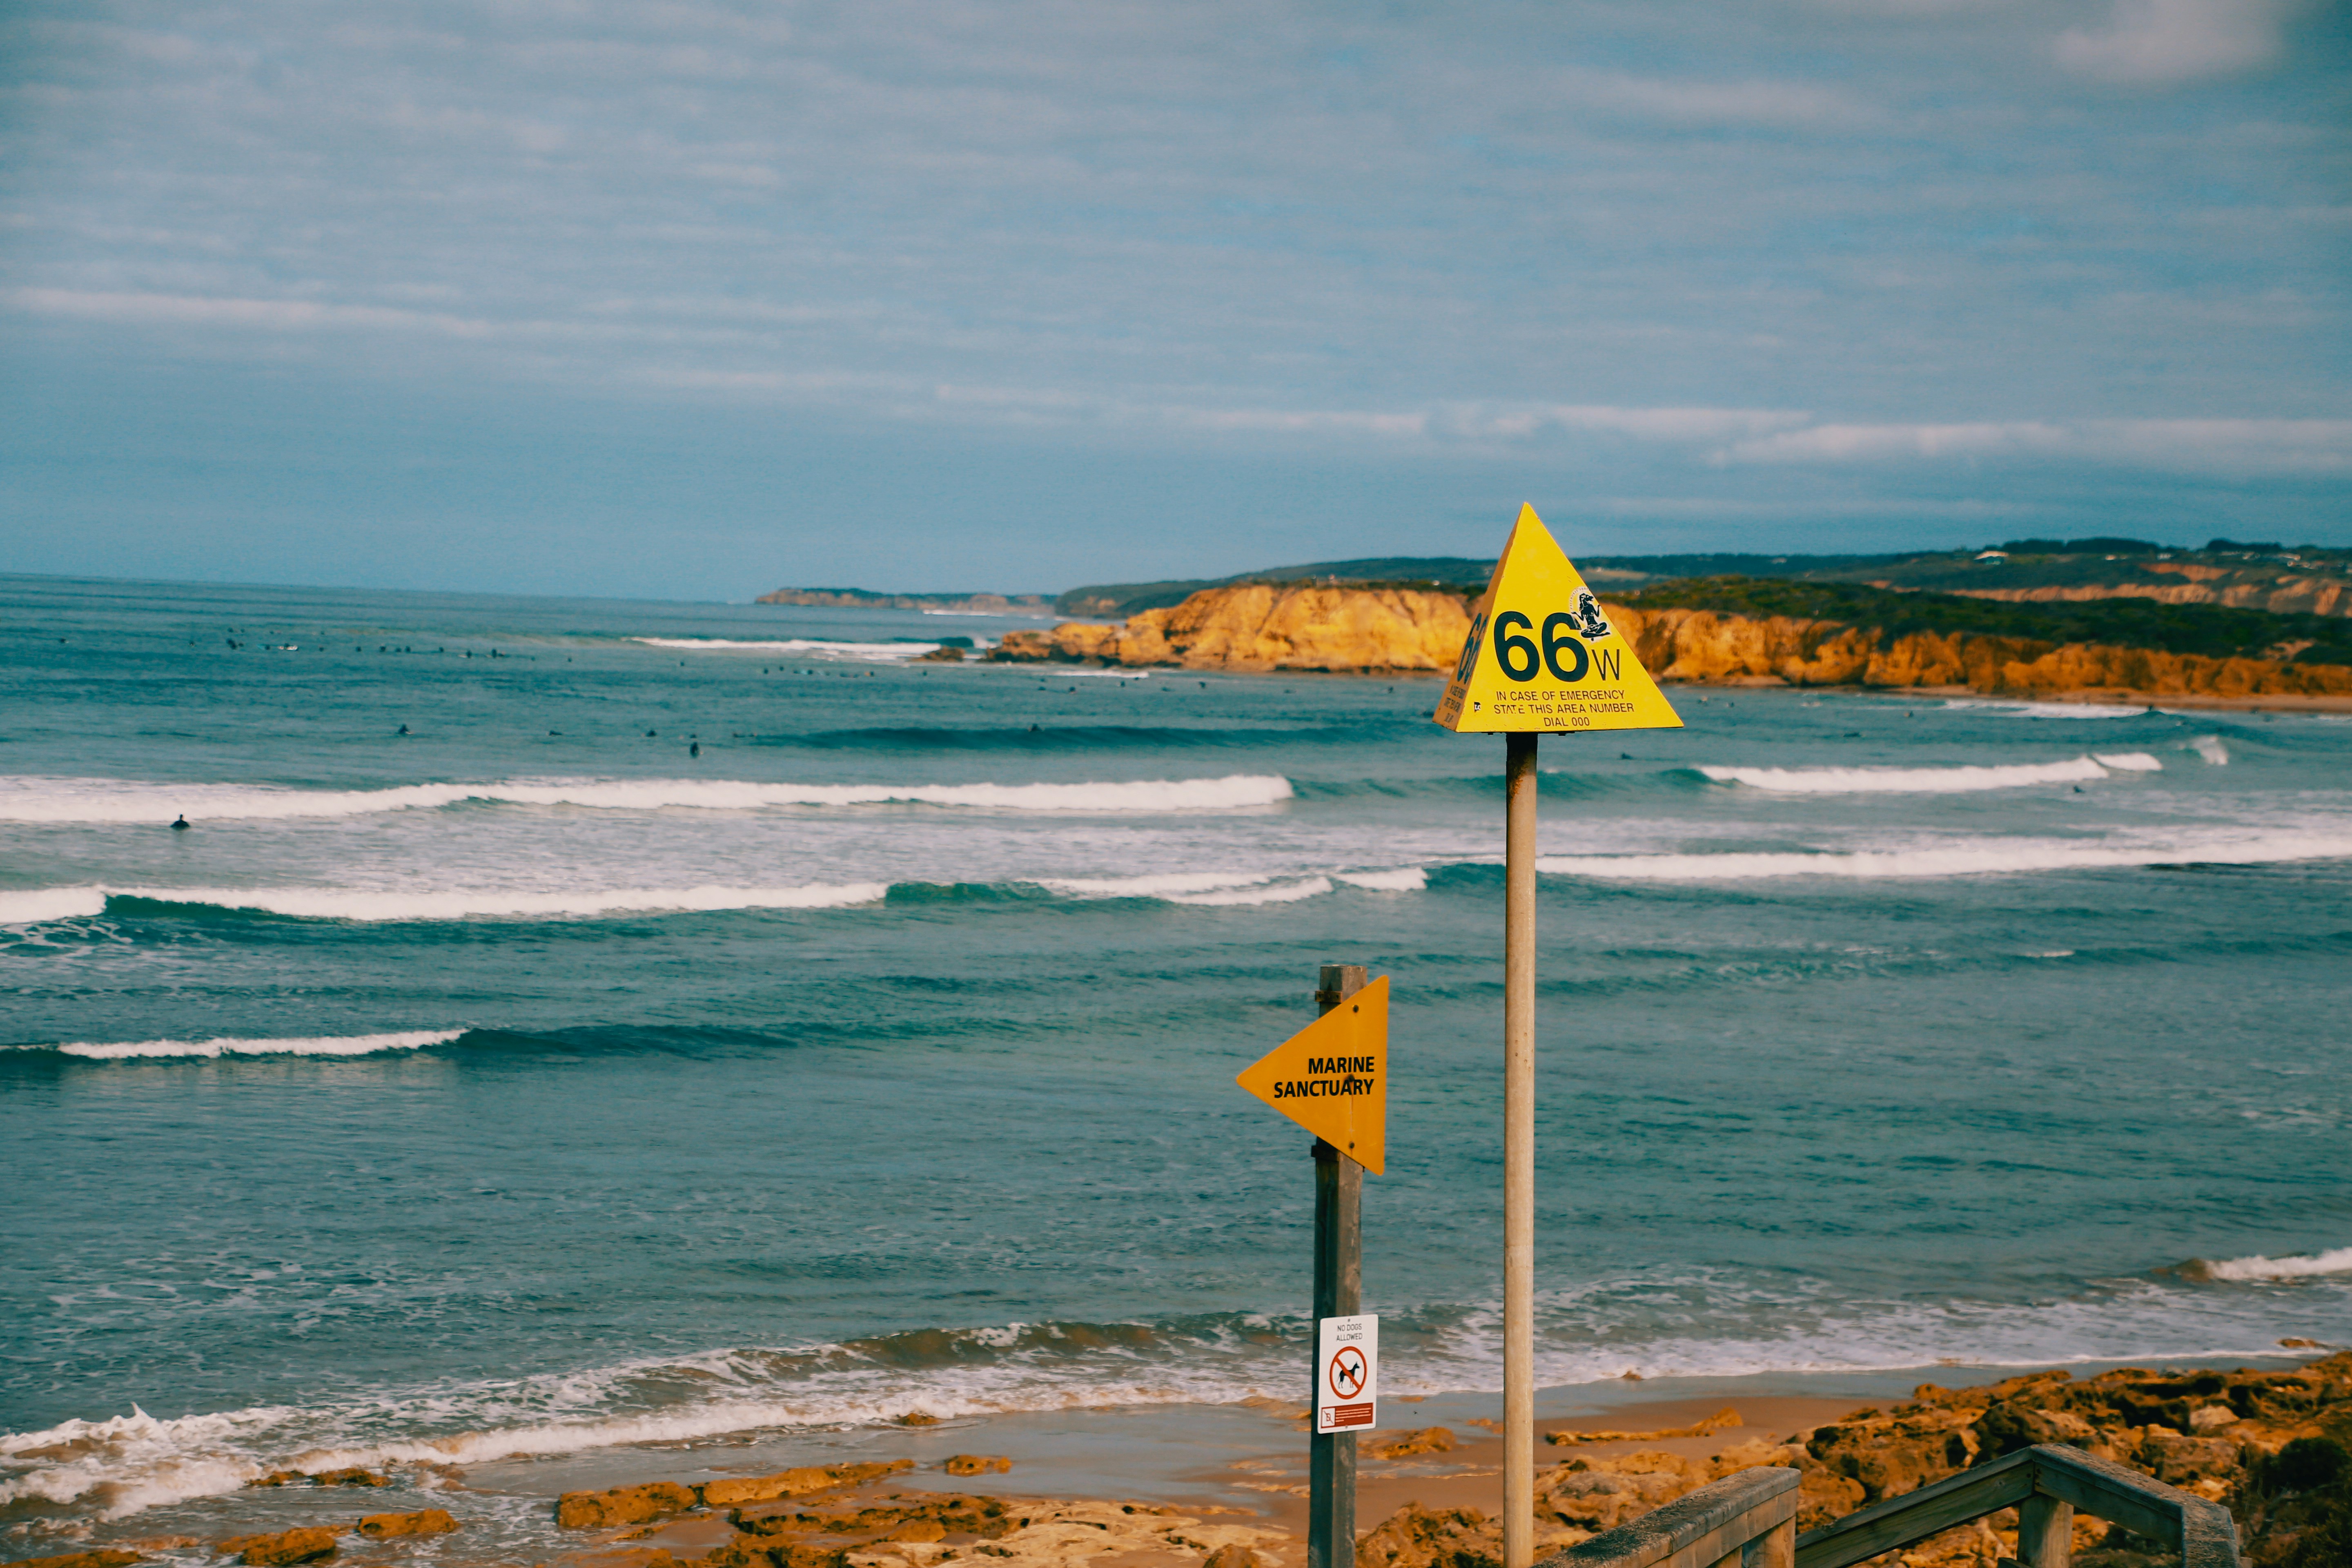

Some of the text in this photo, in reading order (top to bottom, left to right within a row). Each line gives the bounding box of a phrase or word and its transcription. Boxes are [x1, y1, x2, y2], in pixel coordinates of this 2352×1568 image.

[1496, 690, 1625, 701] IN CASE OF EMERGENCY
[1494, 703, 1635, 714] STATE THIS AREA NUMBER
[1544, 717, 1590, 727] DIAL 000
[1308, 1056, 1374, 1074] MARINE
[1274, 1079, 1374, 1098] SANCTUARY
[1336, 1333, 1363, 1341] ALLOWED
